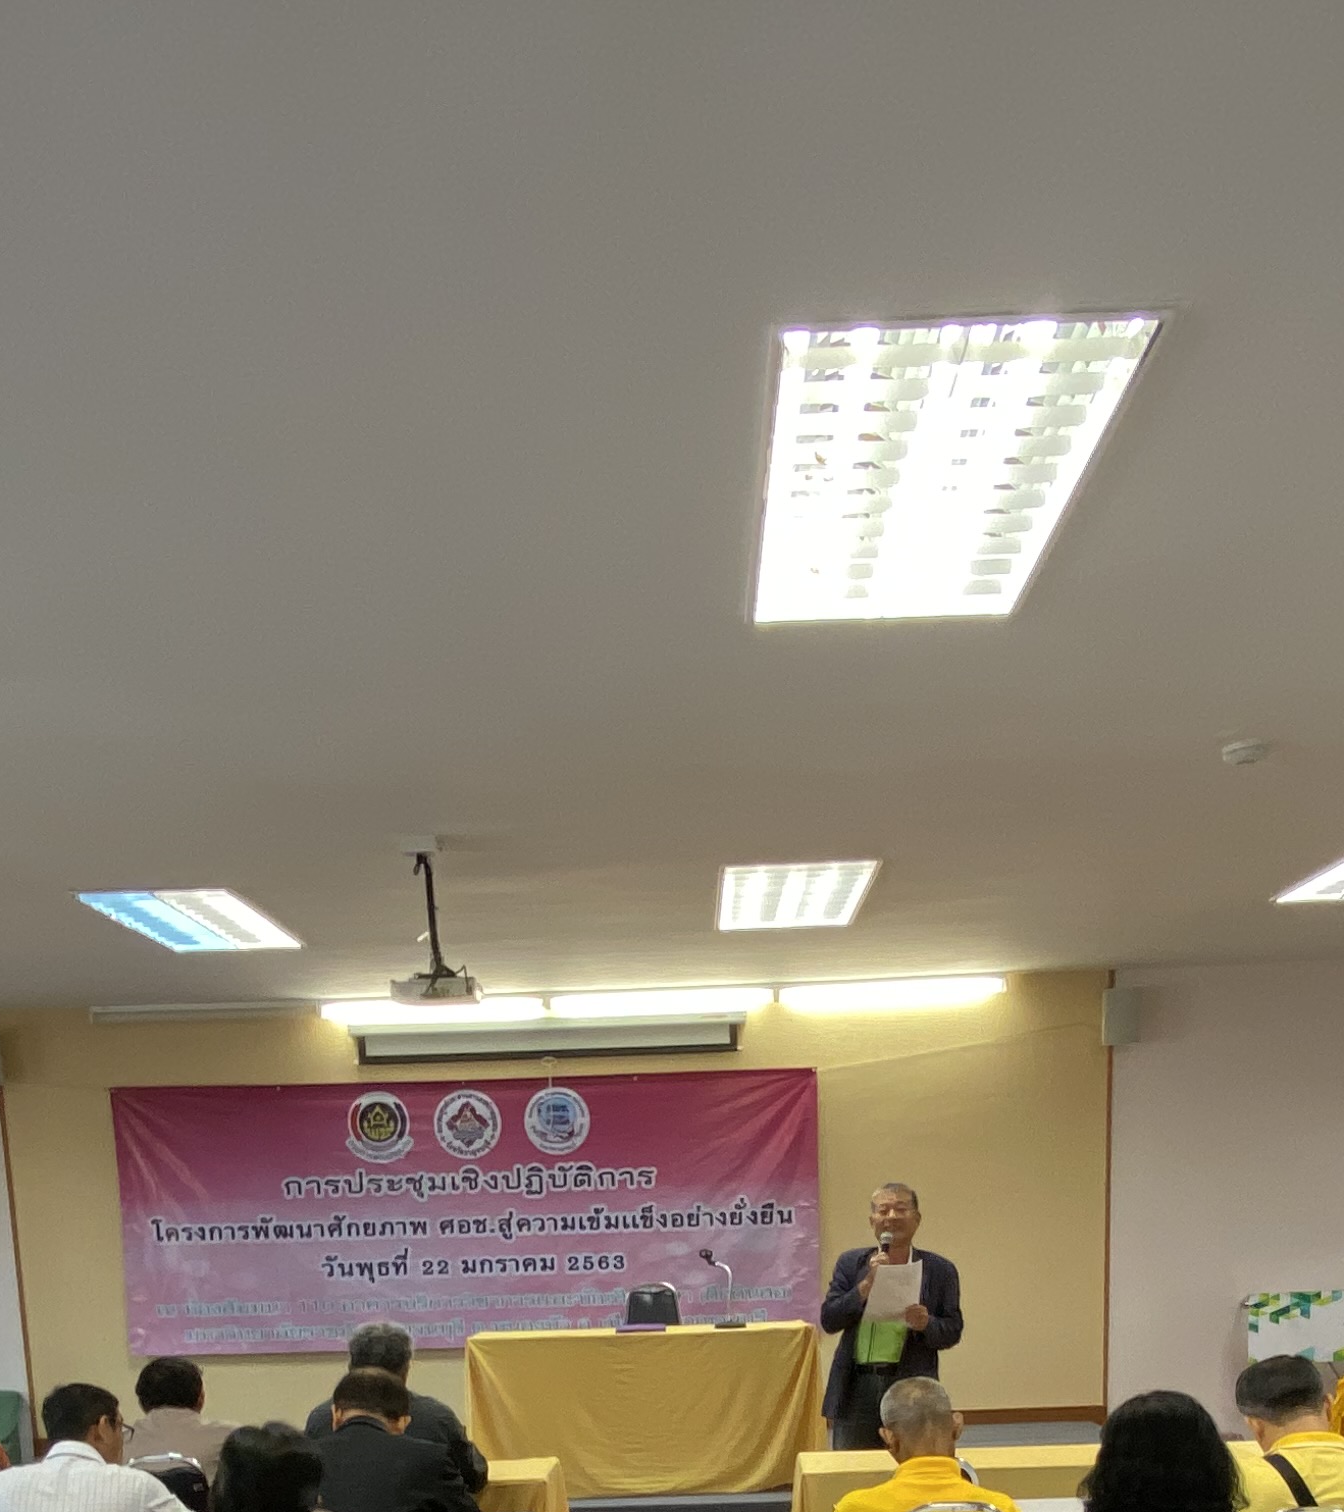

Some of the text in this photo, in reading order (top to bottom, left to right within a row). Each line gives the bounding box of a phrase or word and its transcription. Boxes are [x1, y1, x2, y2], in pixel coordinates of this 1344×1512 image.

[283, 1165, 655, 1200] การประชุมเชิงปฏิบัติการ
[151, 1215, 427, 1242] โครงการพัฒนาศักยภาพ
[321, 1248, 625, 1283] วันพุธที่ 22 มกราคม 2563
